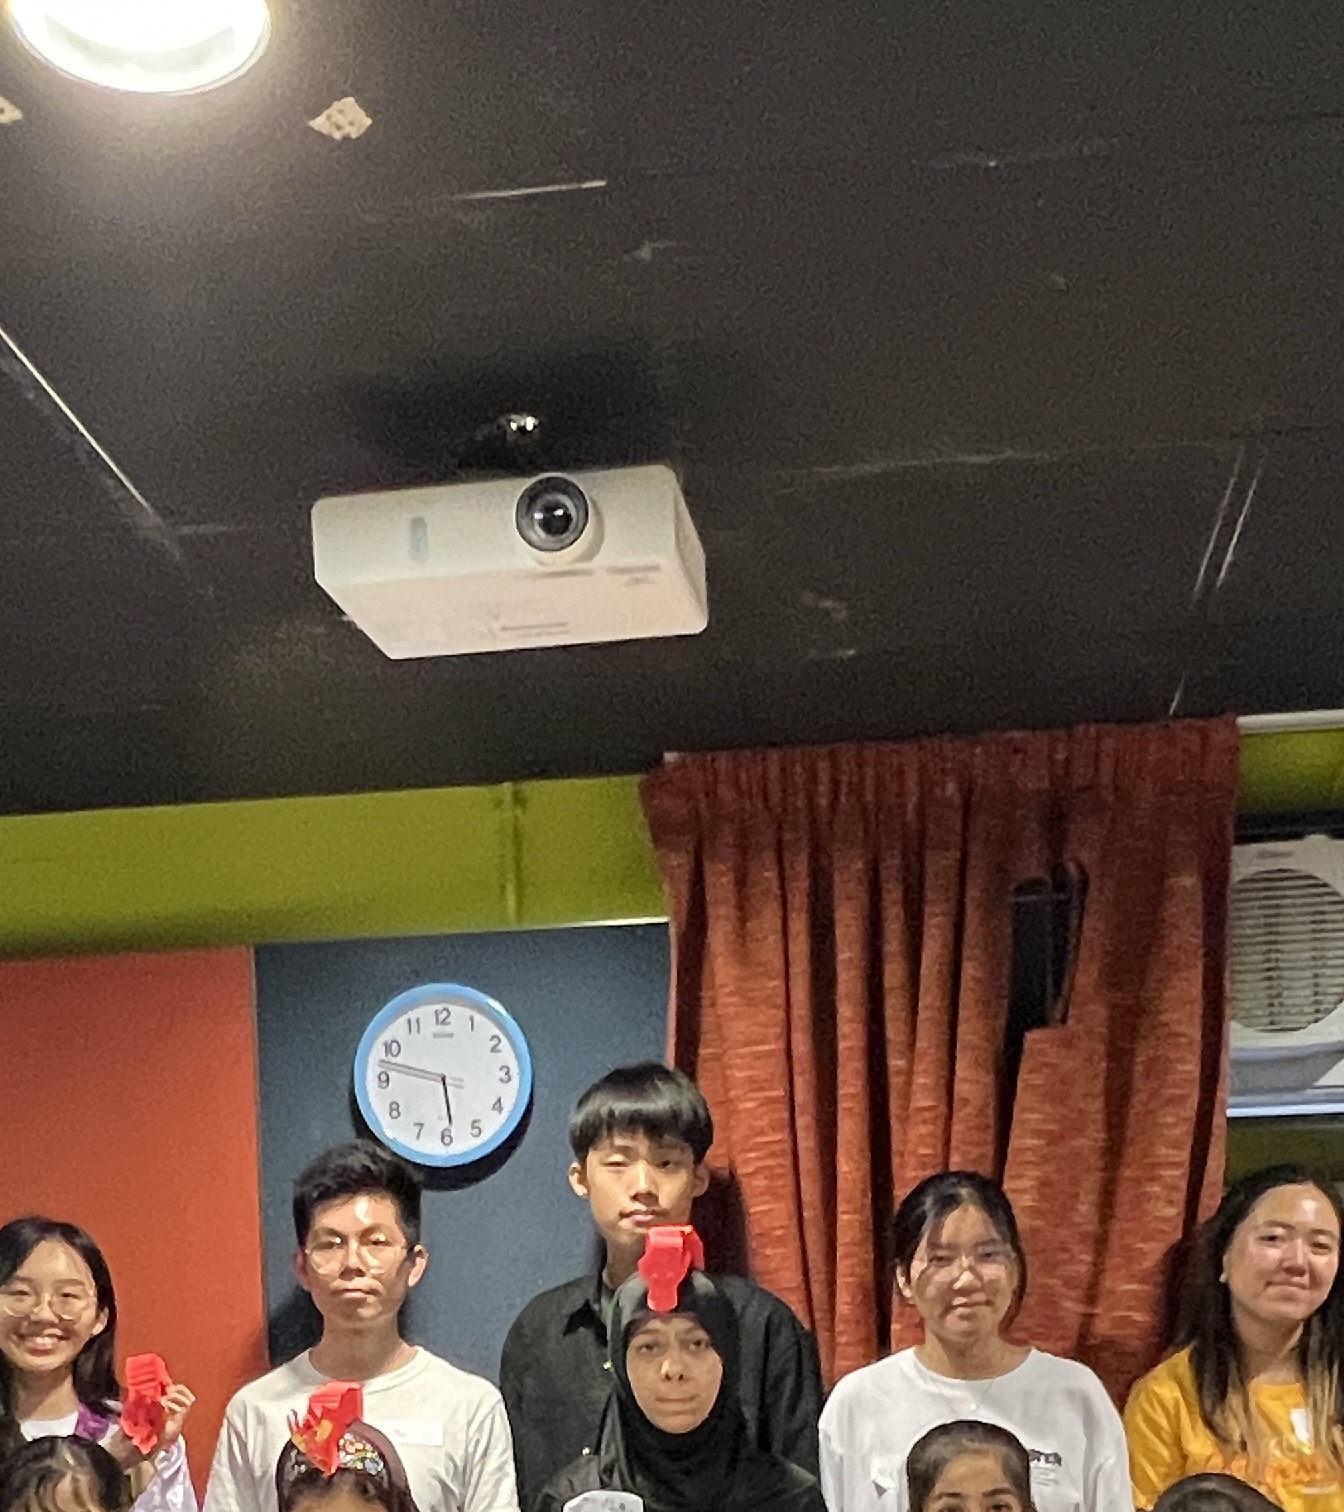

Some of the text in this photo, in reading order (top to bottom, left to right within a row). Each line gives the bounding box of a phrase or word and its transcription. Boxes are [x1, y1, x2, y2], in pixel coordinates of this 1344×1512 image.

[407, 1017, 421, 1035] 11
[434, 1007, 452, 1026] 12
[468, 1014, 476, 1032] 1
[383, 1038, 402, 1058] 10
[489, 1034, 502, 1053] 2
[377, 1070, 390, 1089] 9
[499, 1065, 512, 1084] 3
[388, 1101, 402, 1119] 8
[491, 1097, 504, 1115] 4
[413, 1122, 425, 1140] 7
[440, 1126, 453, 1146] 6
[470, 1118, 482, 1138] 5
